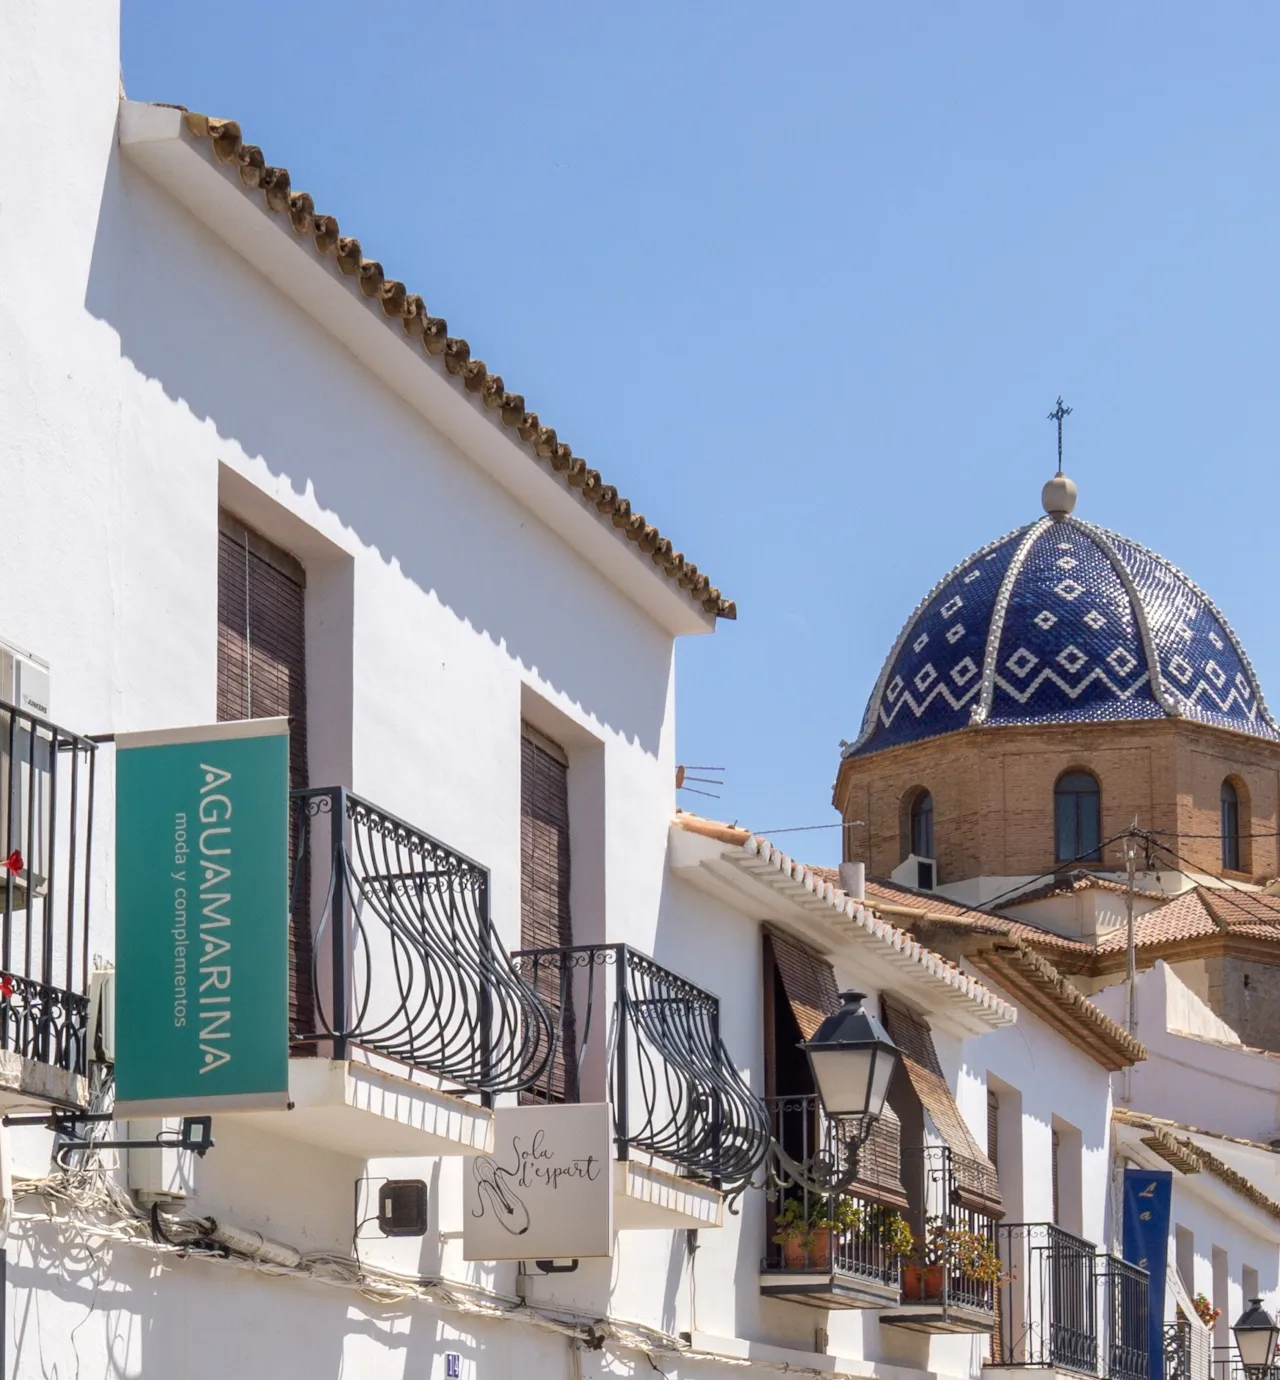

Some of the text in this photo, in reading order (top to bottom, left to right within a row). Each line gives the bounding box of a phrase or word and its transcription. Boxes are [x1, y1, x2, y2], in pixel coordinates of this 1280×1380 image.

[171, 812, 190, 1028] moda y complementos
[198, 763, 233, 1075] AGUAMARINA
[506, 1130, 554, 1176] Sola
[448, 1355, 459, 1376] 14
